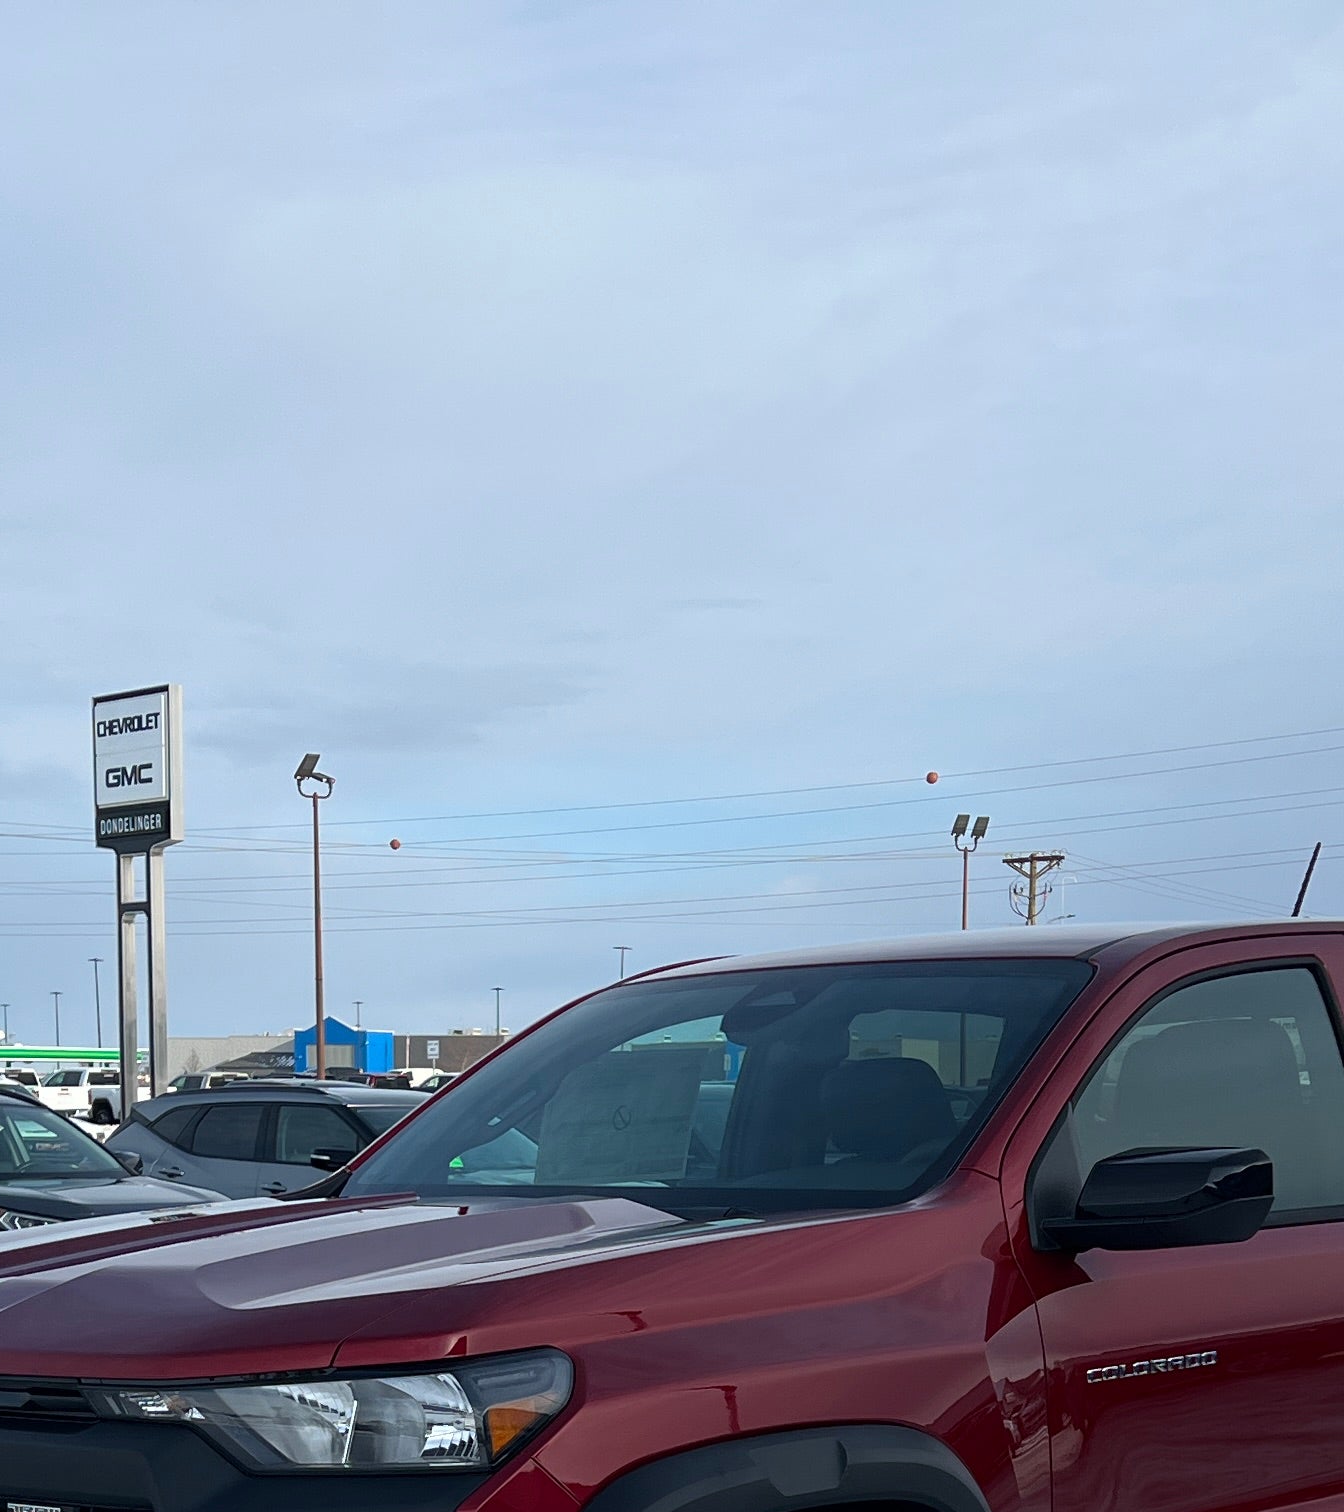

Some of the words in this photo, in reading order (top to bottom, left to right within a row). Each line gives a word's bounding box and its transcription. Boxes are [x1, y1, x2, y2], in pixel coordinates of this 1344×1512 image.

[96, 712, 161, 738] CHEVROLET
[105, 763, 153, 788] GMC
[100, 813, 163, 836] DONDELINGER
[1086, 1350, 1217, 1384] COLORADO
